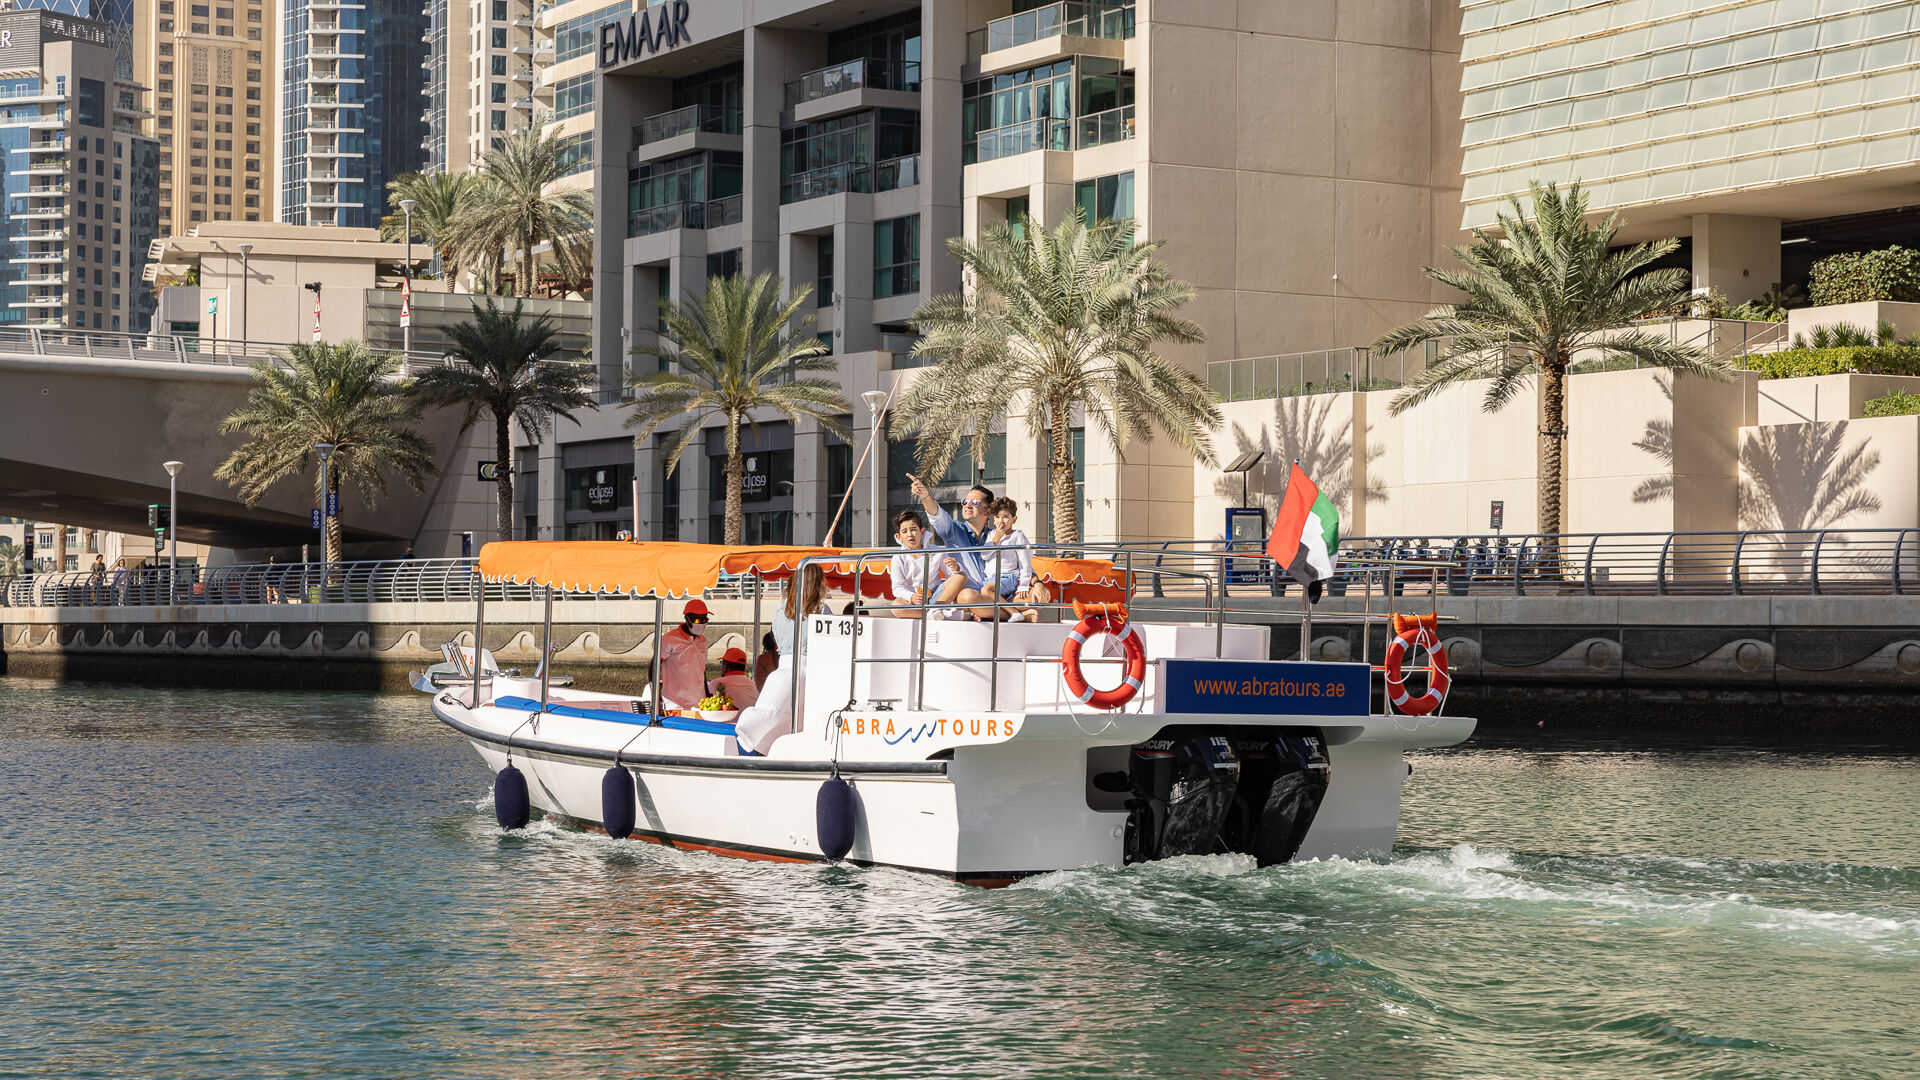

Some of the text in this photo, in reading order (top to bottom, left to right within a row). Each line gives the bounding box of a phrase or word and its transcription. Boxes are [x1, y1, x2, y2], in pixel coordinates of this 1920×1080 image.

[0, 30, 13, 48] R
[599, 1, 692, 67] EMAAR
[741, 473, 766, 495] clipse
[589, 486, 614, 504] eclipse
[816, 620, 863, 636] DT 139
[1194, 676, 1345, 697] www.abratours.ae
[841, 718, 1014, 737] ABRA TOURS
[1210, 736, 1229, 746] 115
[1303, 736, 1319, 746] 115
